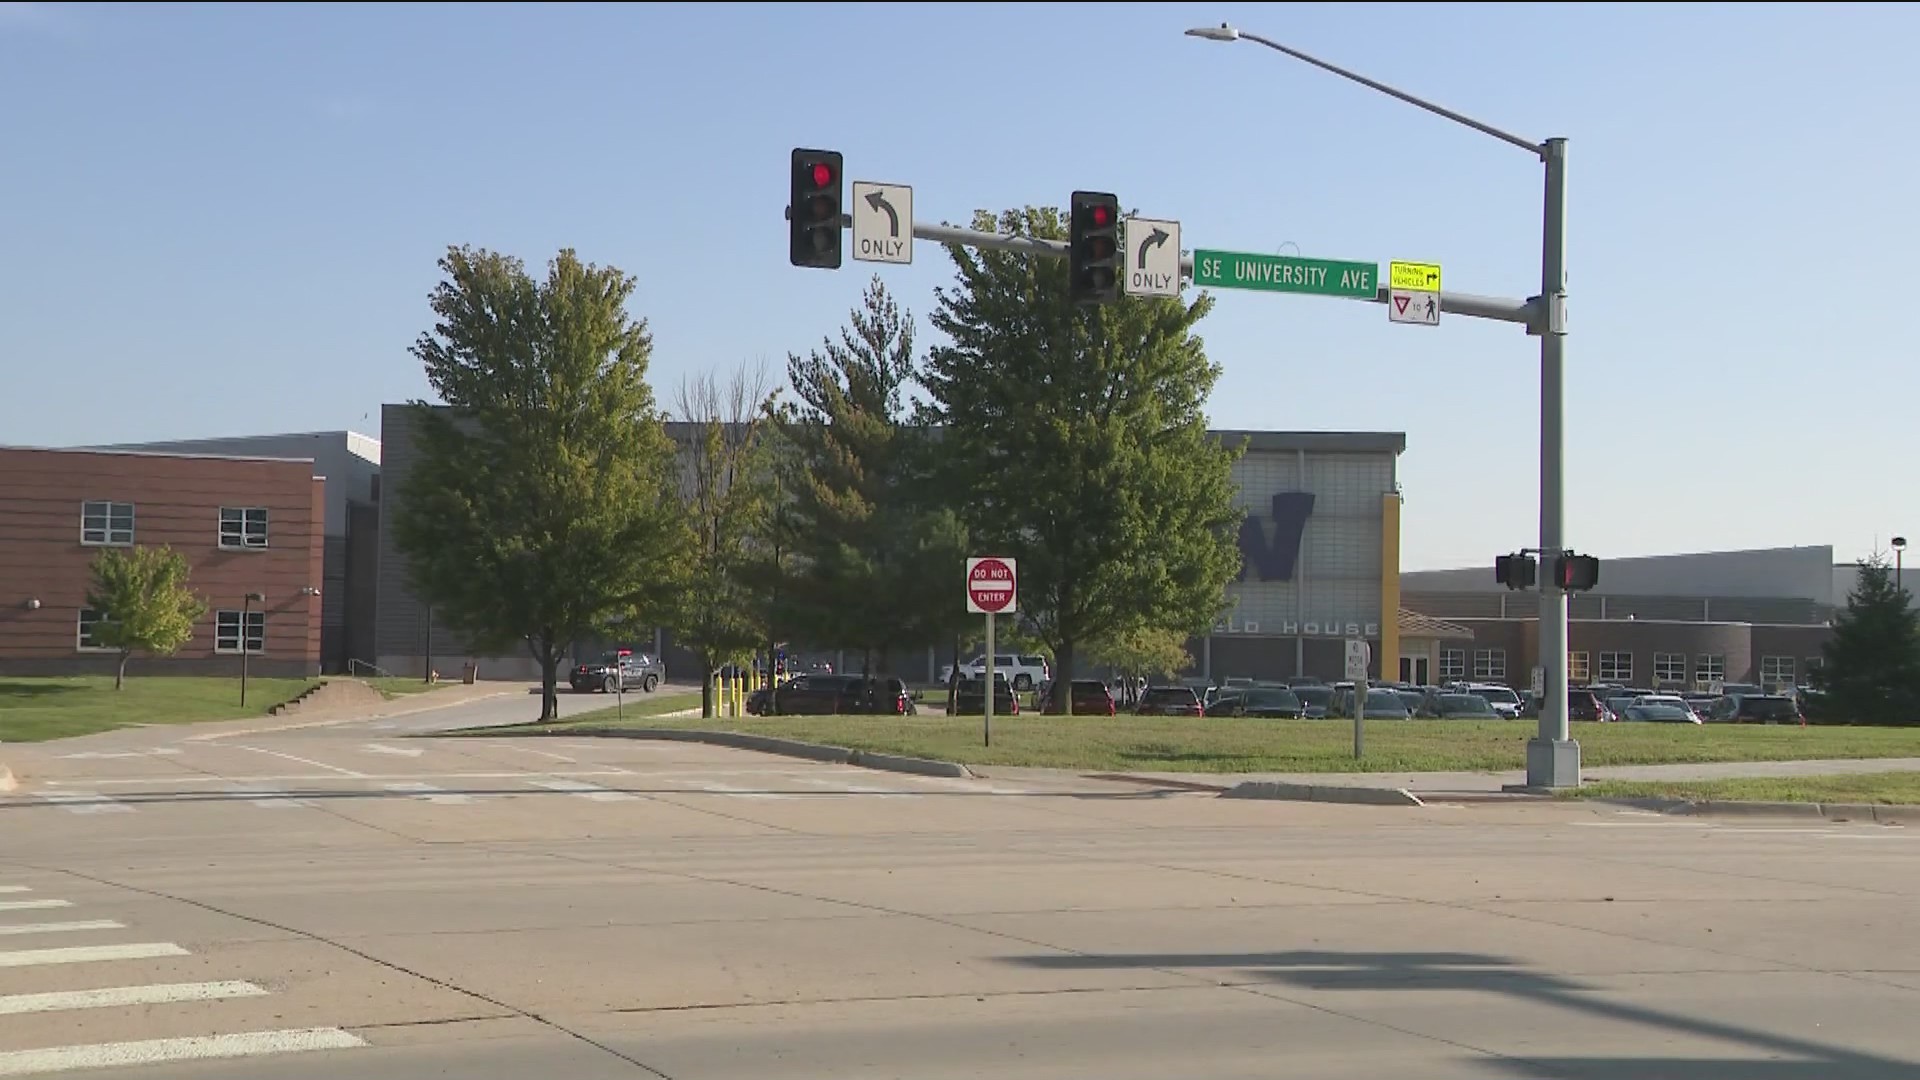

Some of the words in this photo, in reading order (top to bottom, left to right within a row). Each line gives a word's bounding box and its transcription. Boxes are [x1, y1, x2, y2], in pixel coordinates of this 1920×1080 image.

[861, 238, 904, 257] ONLY
[1201, 257, 1222, 279] SE
[1235, 260, 1328, 287] UNIVERSITY
[1340, 269, 1370, 290] AVE
[1394, 265, 1424, 276] TURNING
[1133, 272, 1172, 289] ONLY
[1393, 276, 1425, 287] VEHICLES
[974, 569, 987, 579] DO
[991, 569, 1009, 579] NOT
[978, 592, 1006, 602] ENTER
[1283, 621, 1378, 635] HOUSE
